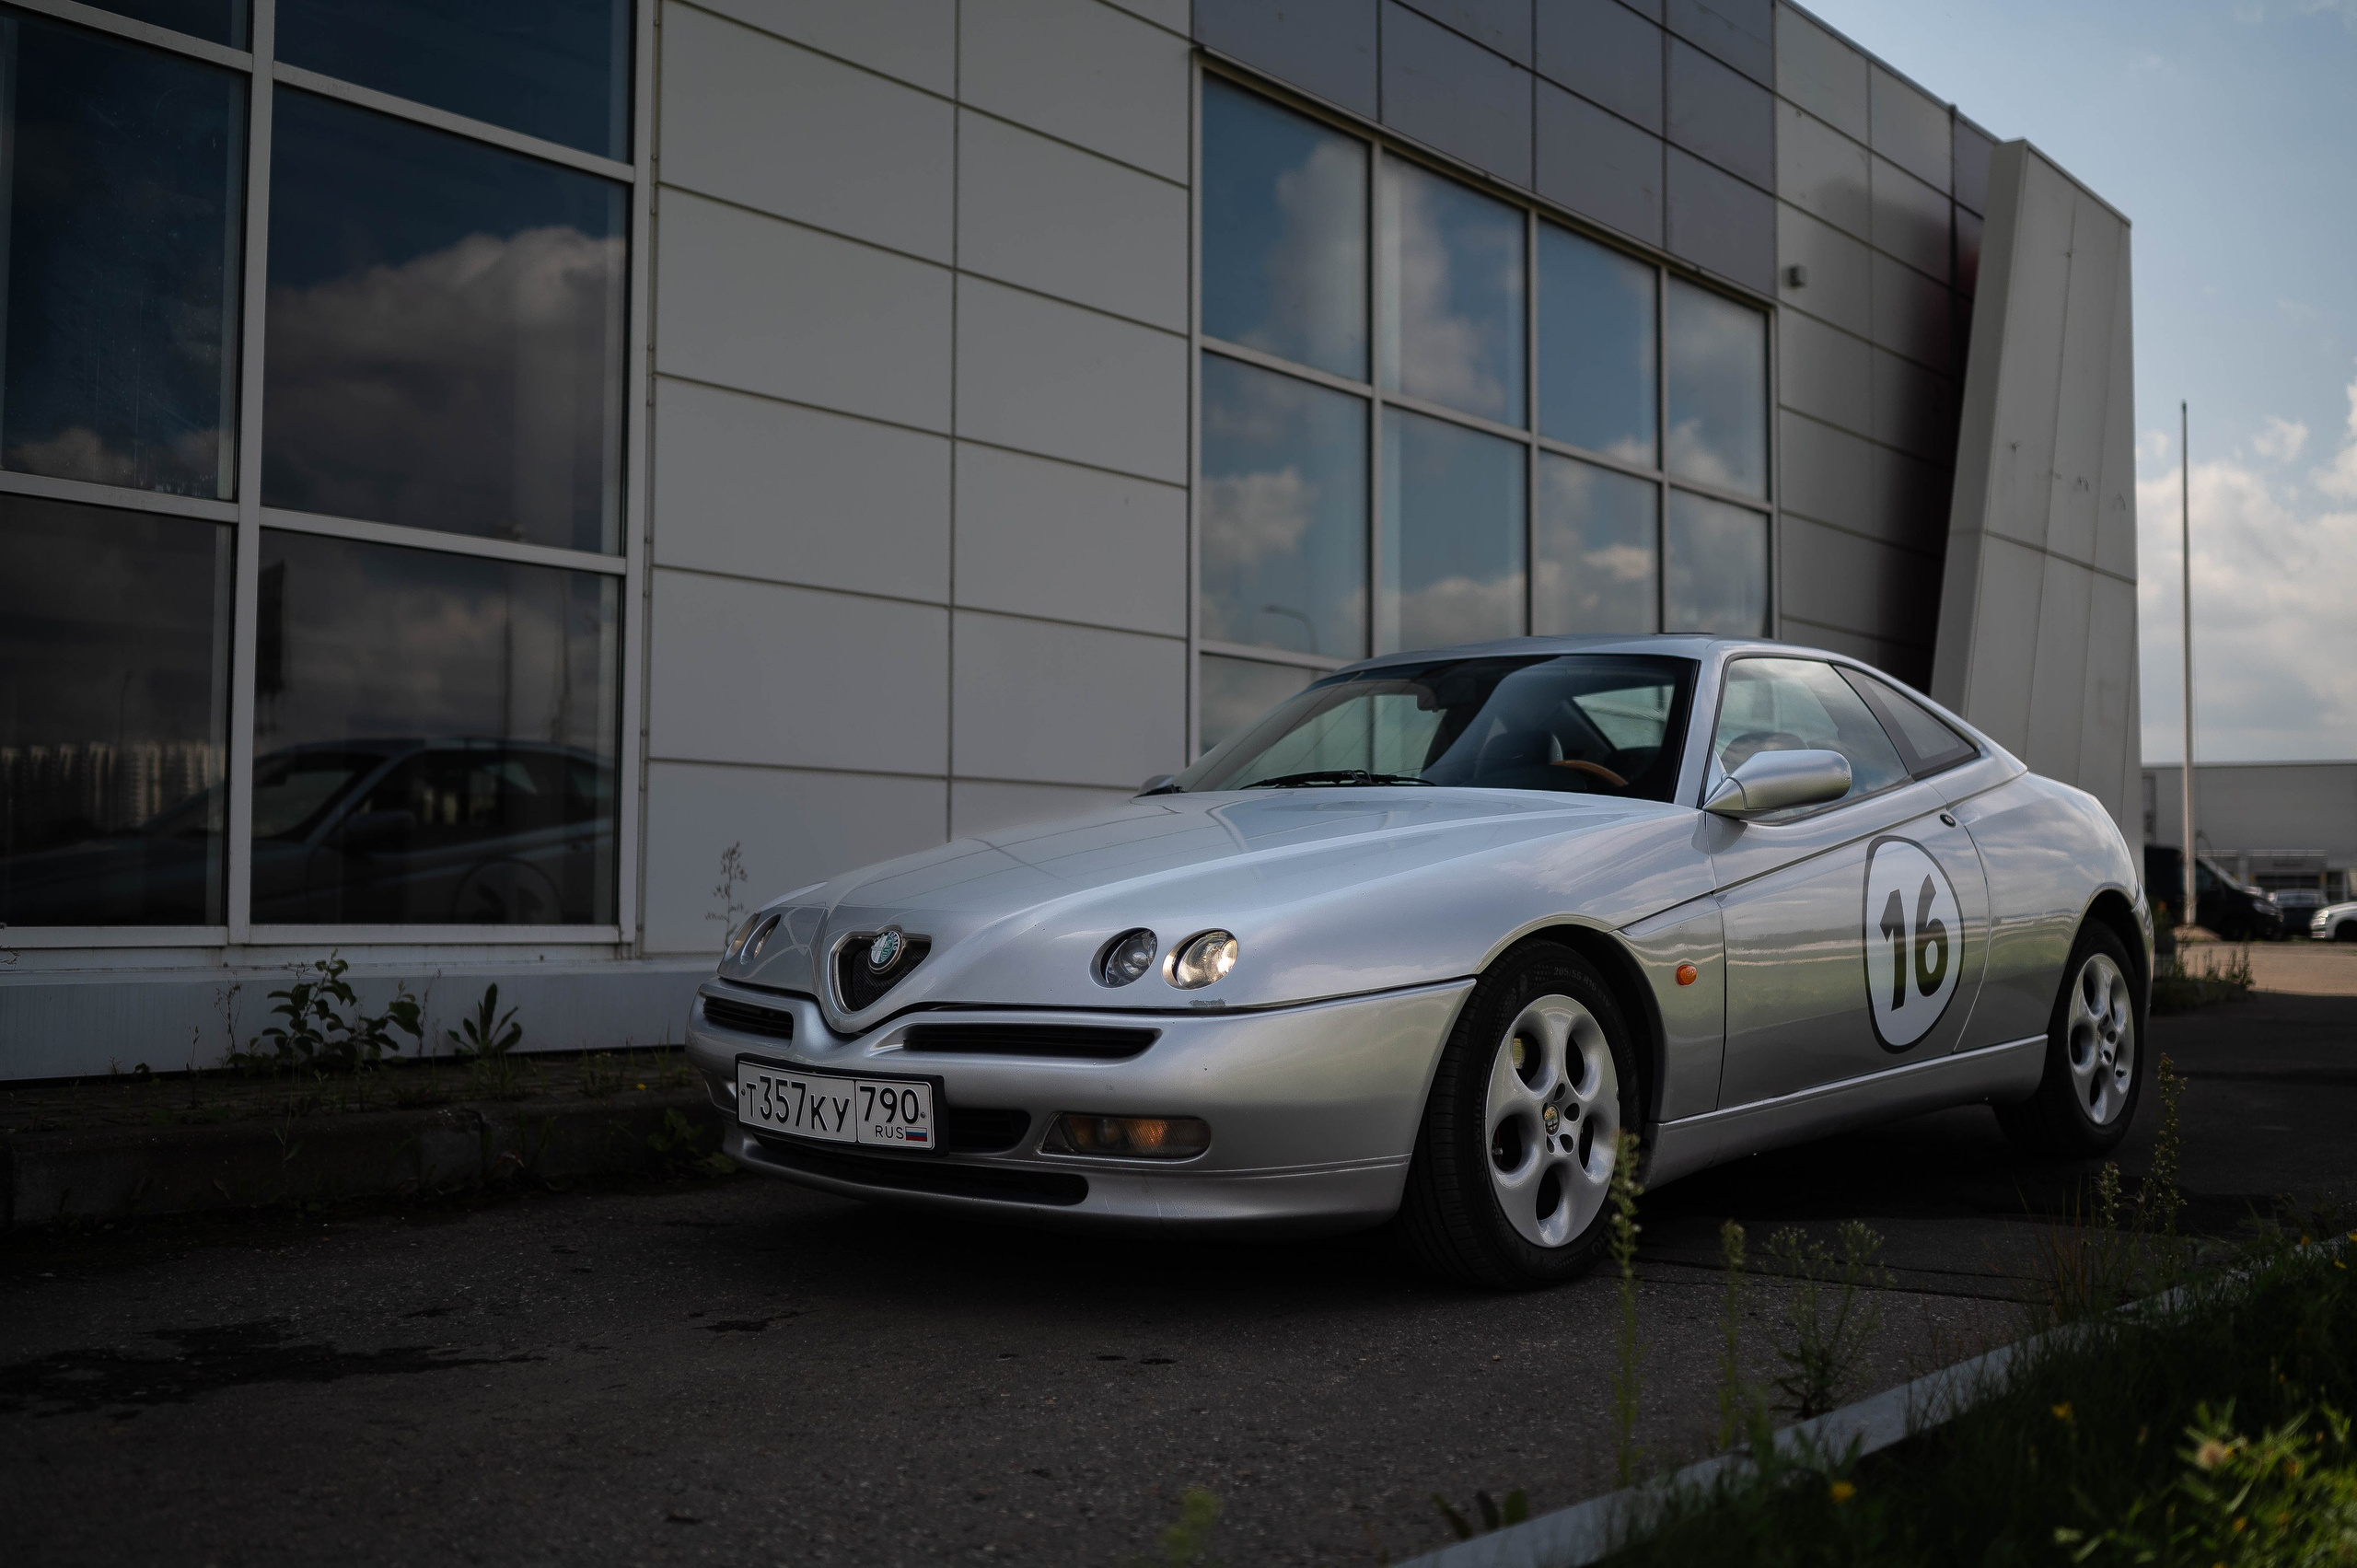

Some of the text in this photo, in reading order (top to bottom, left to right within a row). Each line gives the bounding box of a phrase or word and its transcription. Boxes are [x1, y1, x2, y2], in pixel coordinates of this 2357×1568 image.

[1879, 874, 1949, 1012] 16
[1553, 966, 1582, 981] 205/55
[1583, 975, 1596, 992] R16
[859, 1086, 919, 1124] 790
[875, 1125, 904, 1140] RUS
